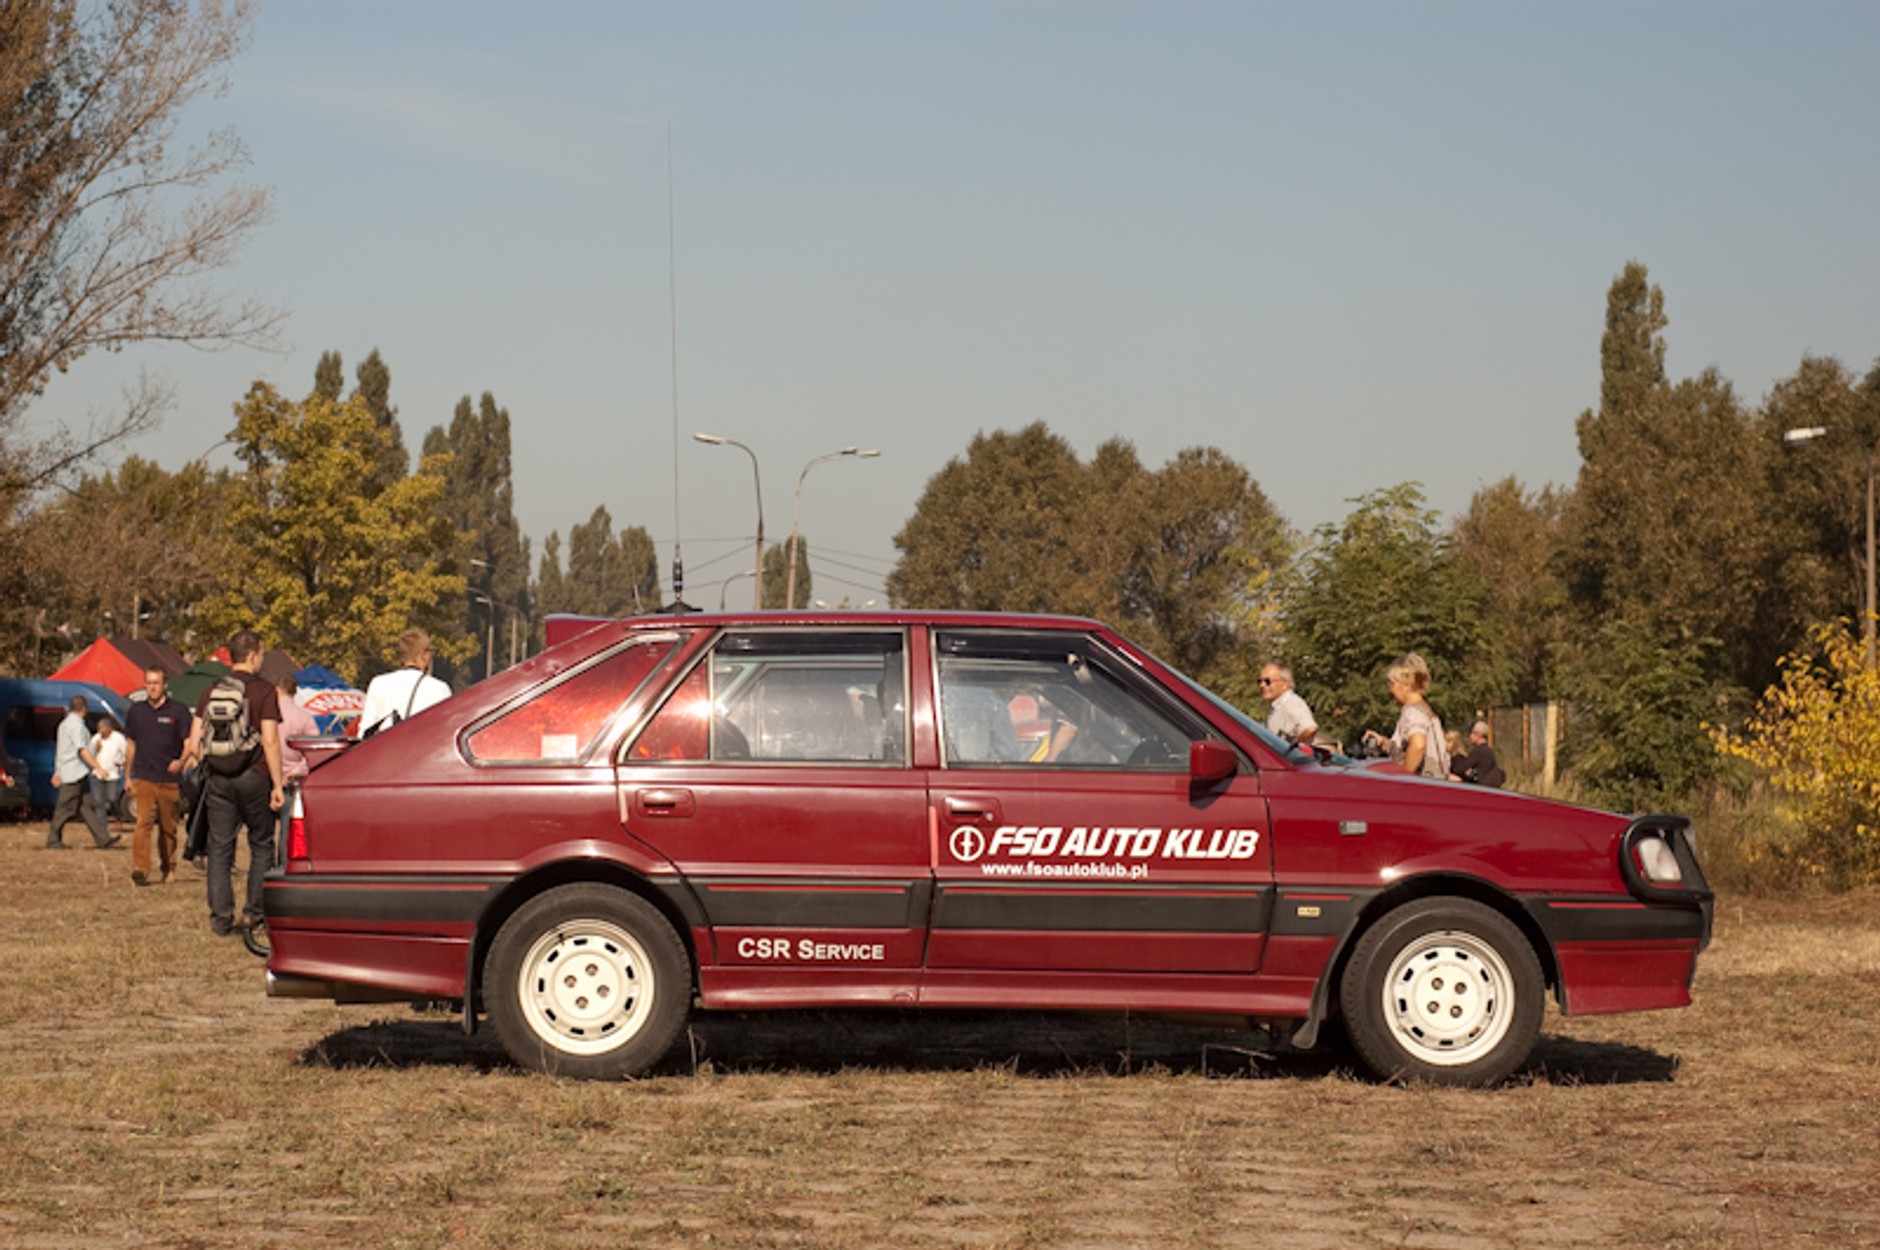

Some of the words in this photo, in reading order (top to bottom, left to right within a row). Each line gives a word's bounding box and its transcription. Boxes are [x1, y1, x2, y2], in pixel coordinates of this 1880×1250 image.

[988, 827, 1062, 856] FSO
[1060, 828, 1162, 857] AUTO
[1162, 829, 1260, 859] KLUB
[981, 861, 1149, 879] www.fsoautoklub.pl
[738, 938, 791, 958] CSR
